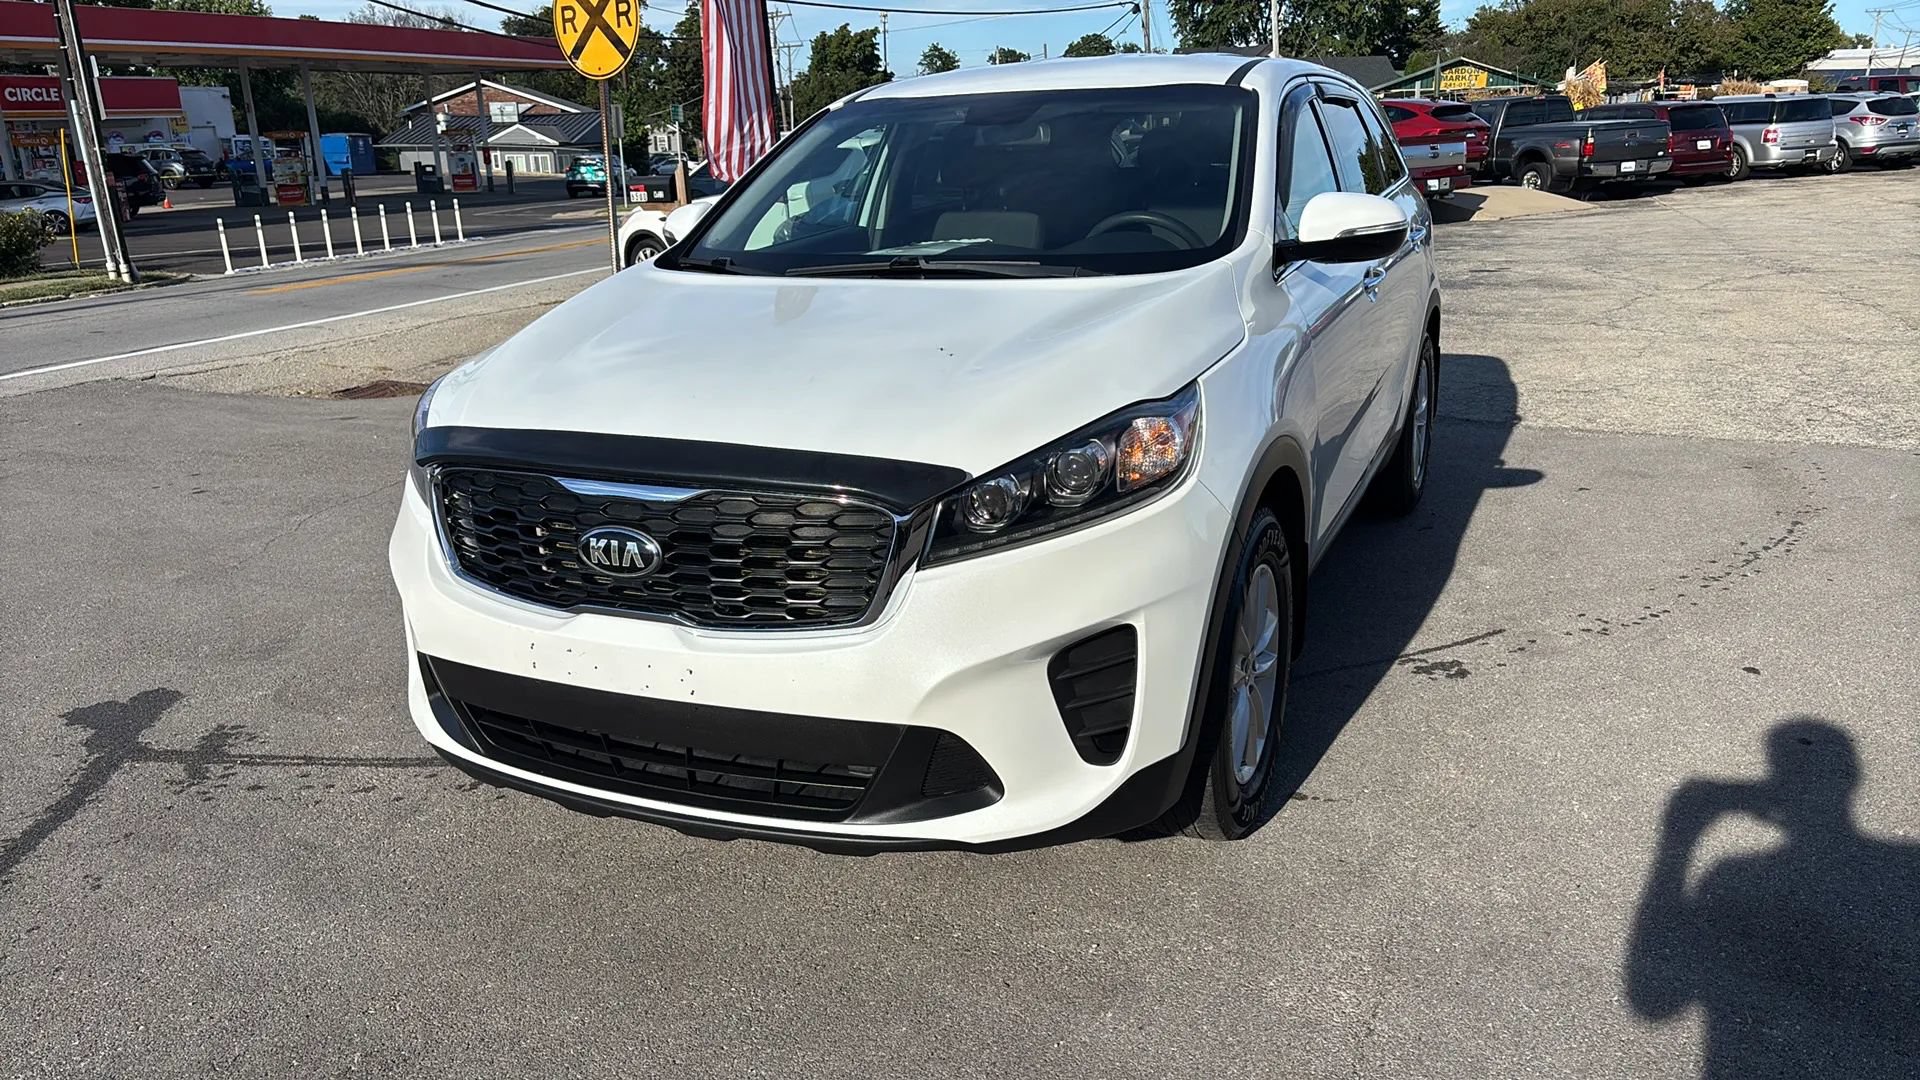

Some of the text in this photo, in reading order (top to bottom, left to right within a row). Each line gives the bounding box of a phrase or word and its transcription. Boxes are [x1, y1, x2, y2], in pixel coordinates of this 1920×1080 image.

[561, 5, 578, 34] R
[615, 0, 632, 28] R
[4, 87, 60, 102] CIRCLE
[589, 537, 645, 568] KIA
